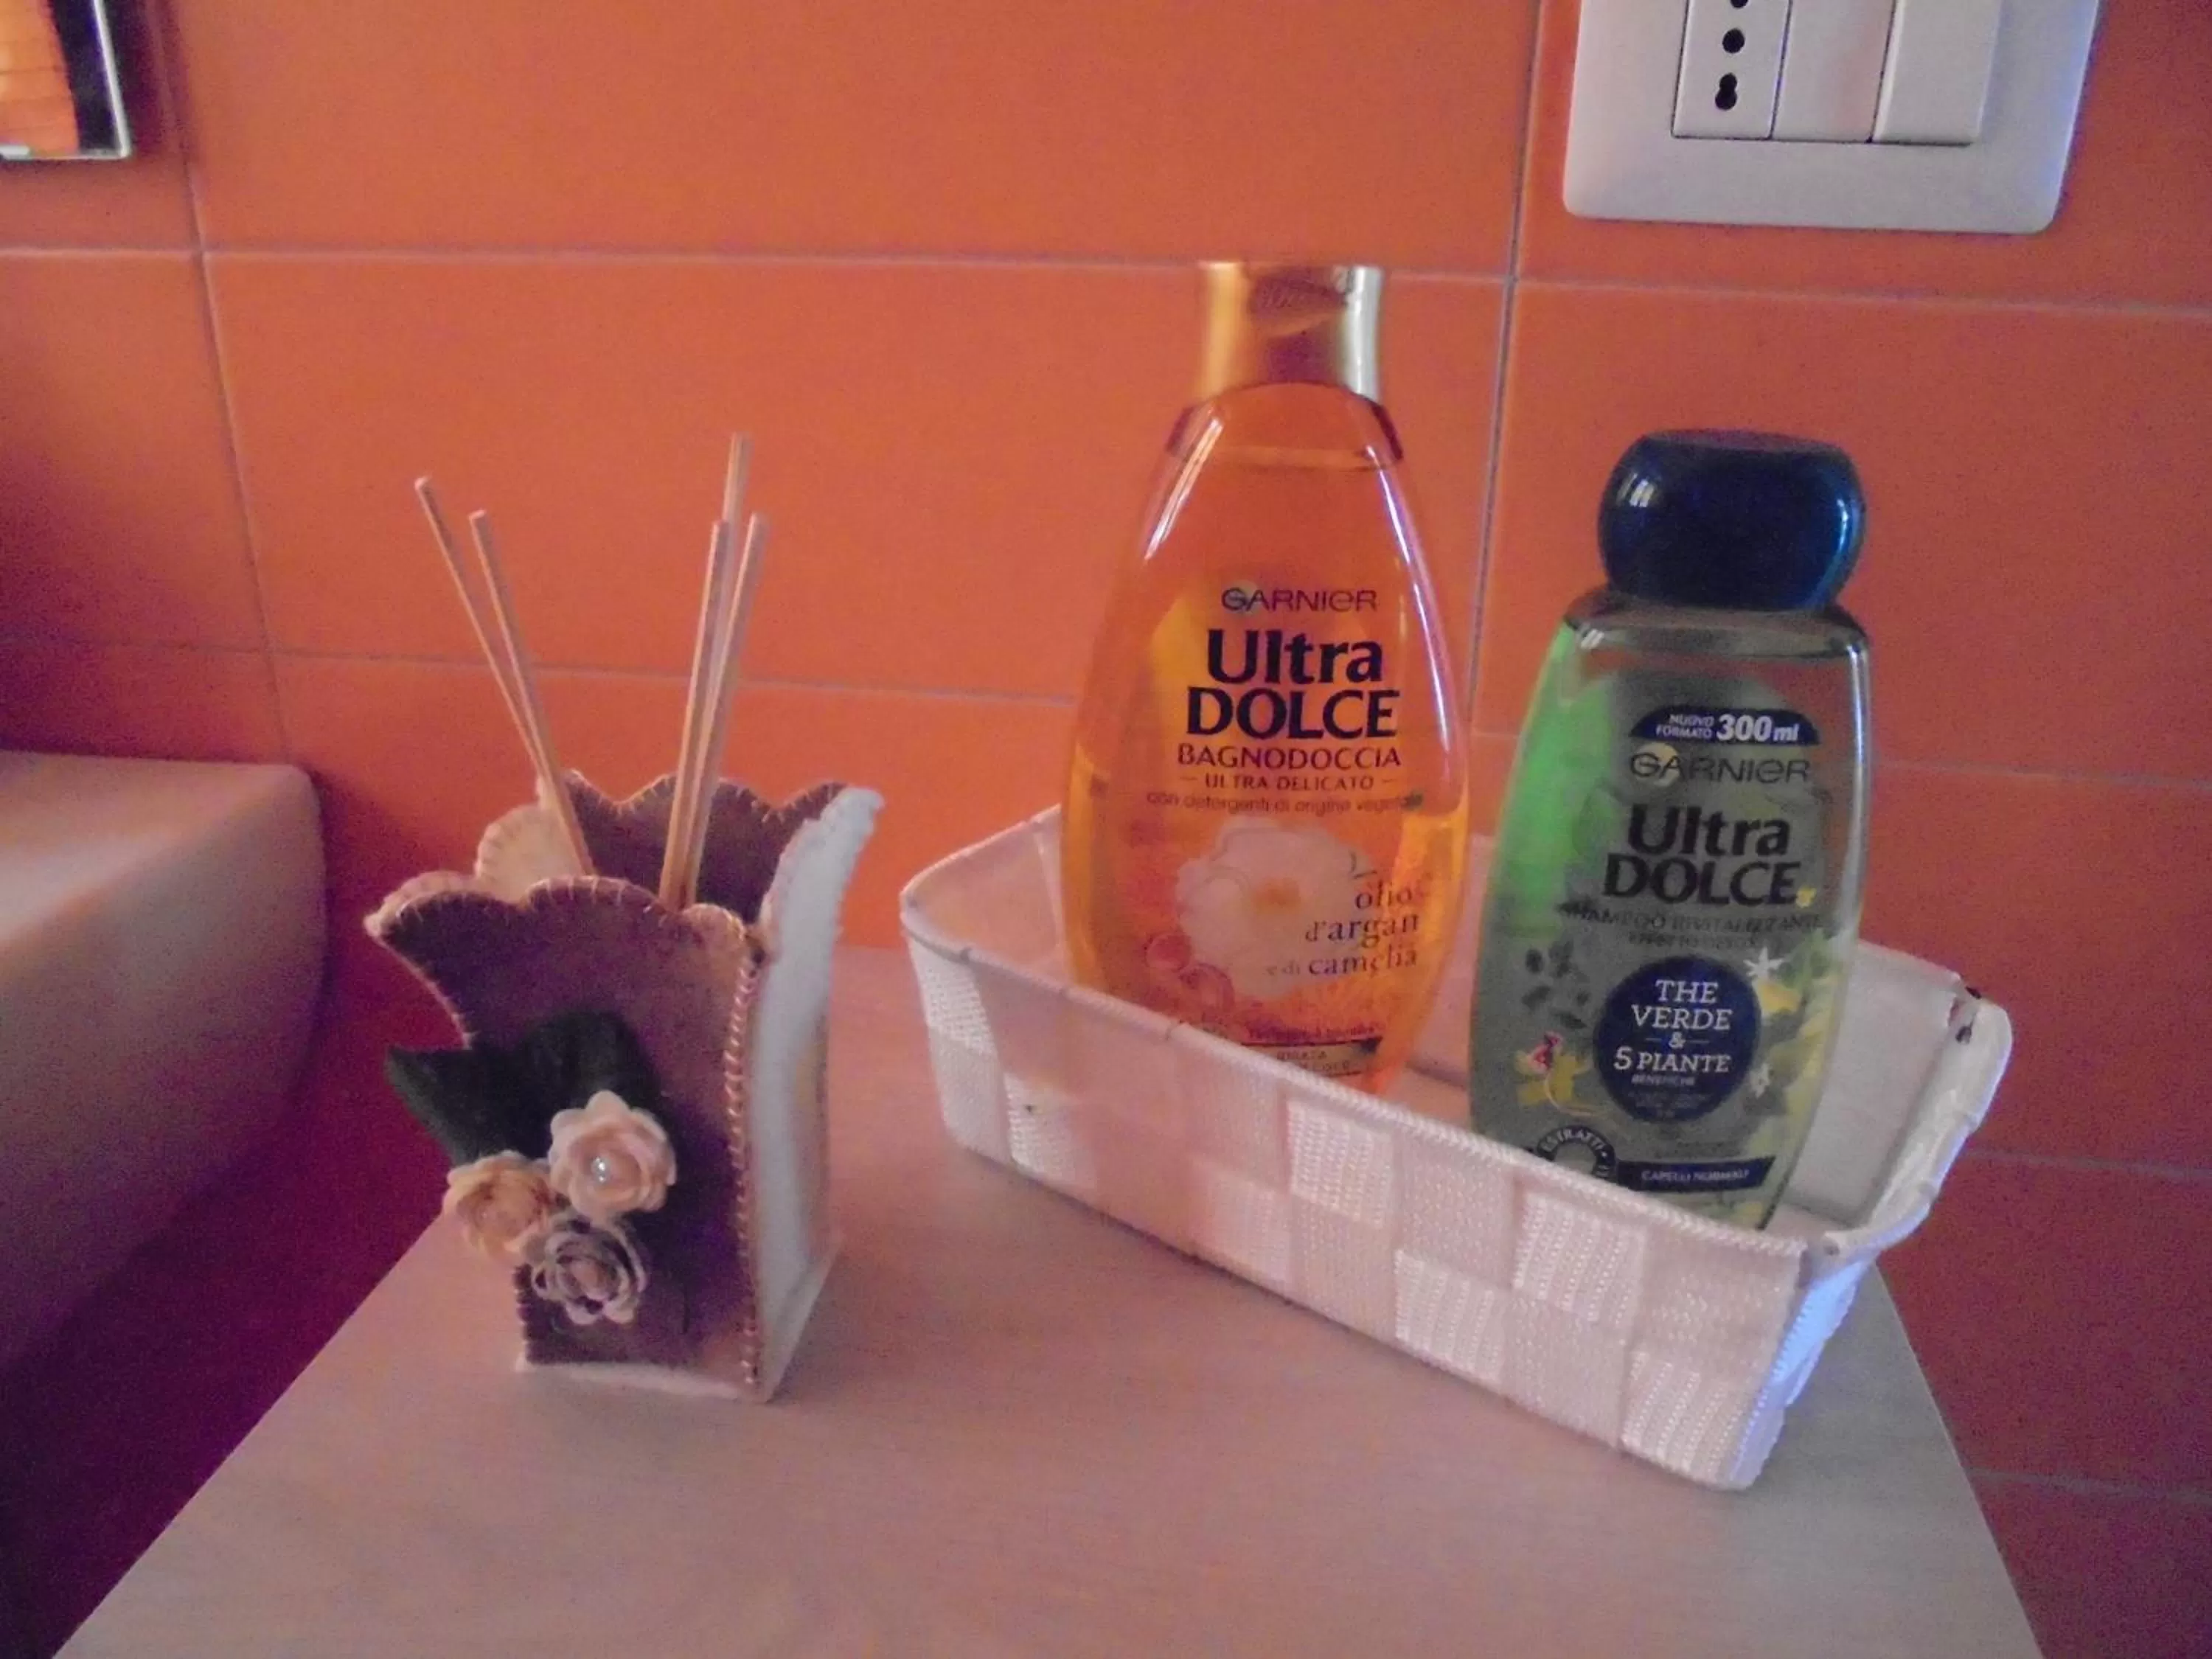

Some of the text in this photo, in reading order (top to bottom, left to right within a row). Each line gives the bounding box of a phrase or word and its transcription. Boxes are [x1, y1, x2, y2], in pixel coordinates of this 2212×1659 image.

[1221, 588, 1378, 611] GARNIER
[1206, 629, 1382, 685] Ultra
[1186, 686, 1400, 739] DOLCE
[1669, 713, 1714, 727] NUOVO
[1655, 725, 1712, 738] FORMATO
[1716, 714, 1800, 742] 300 ml
[1178, 742, 1401, 771] BAGNODOCCIA
[1630, 751, 1810, 785] GARNIER
[1205, 773, 1374, 791] ULTRA DELICATO
[1628, 804, 1791, 856] Ultra
[1601, 852, 1801, 907] DOLCE
[1354, 879, 1413, 911] olio
[1655, 979, 1719, 1004] THE
[1631, 1004, 1733, 1031] VERDE
[1668, 1032, 1686, 1049] &
[1613, 1046, 1732, 1074] 5 PIANTE
